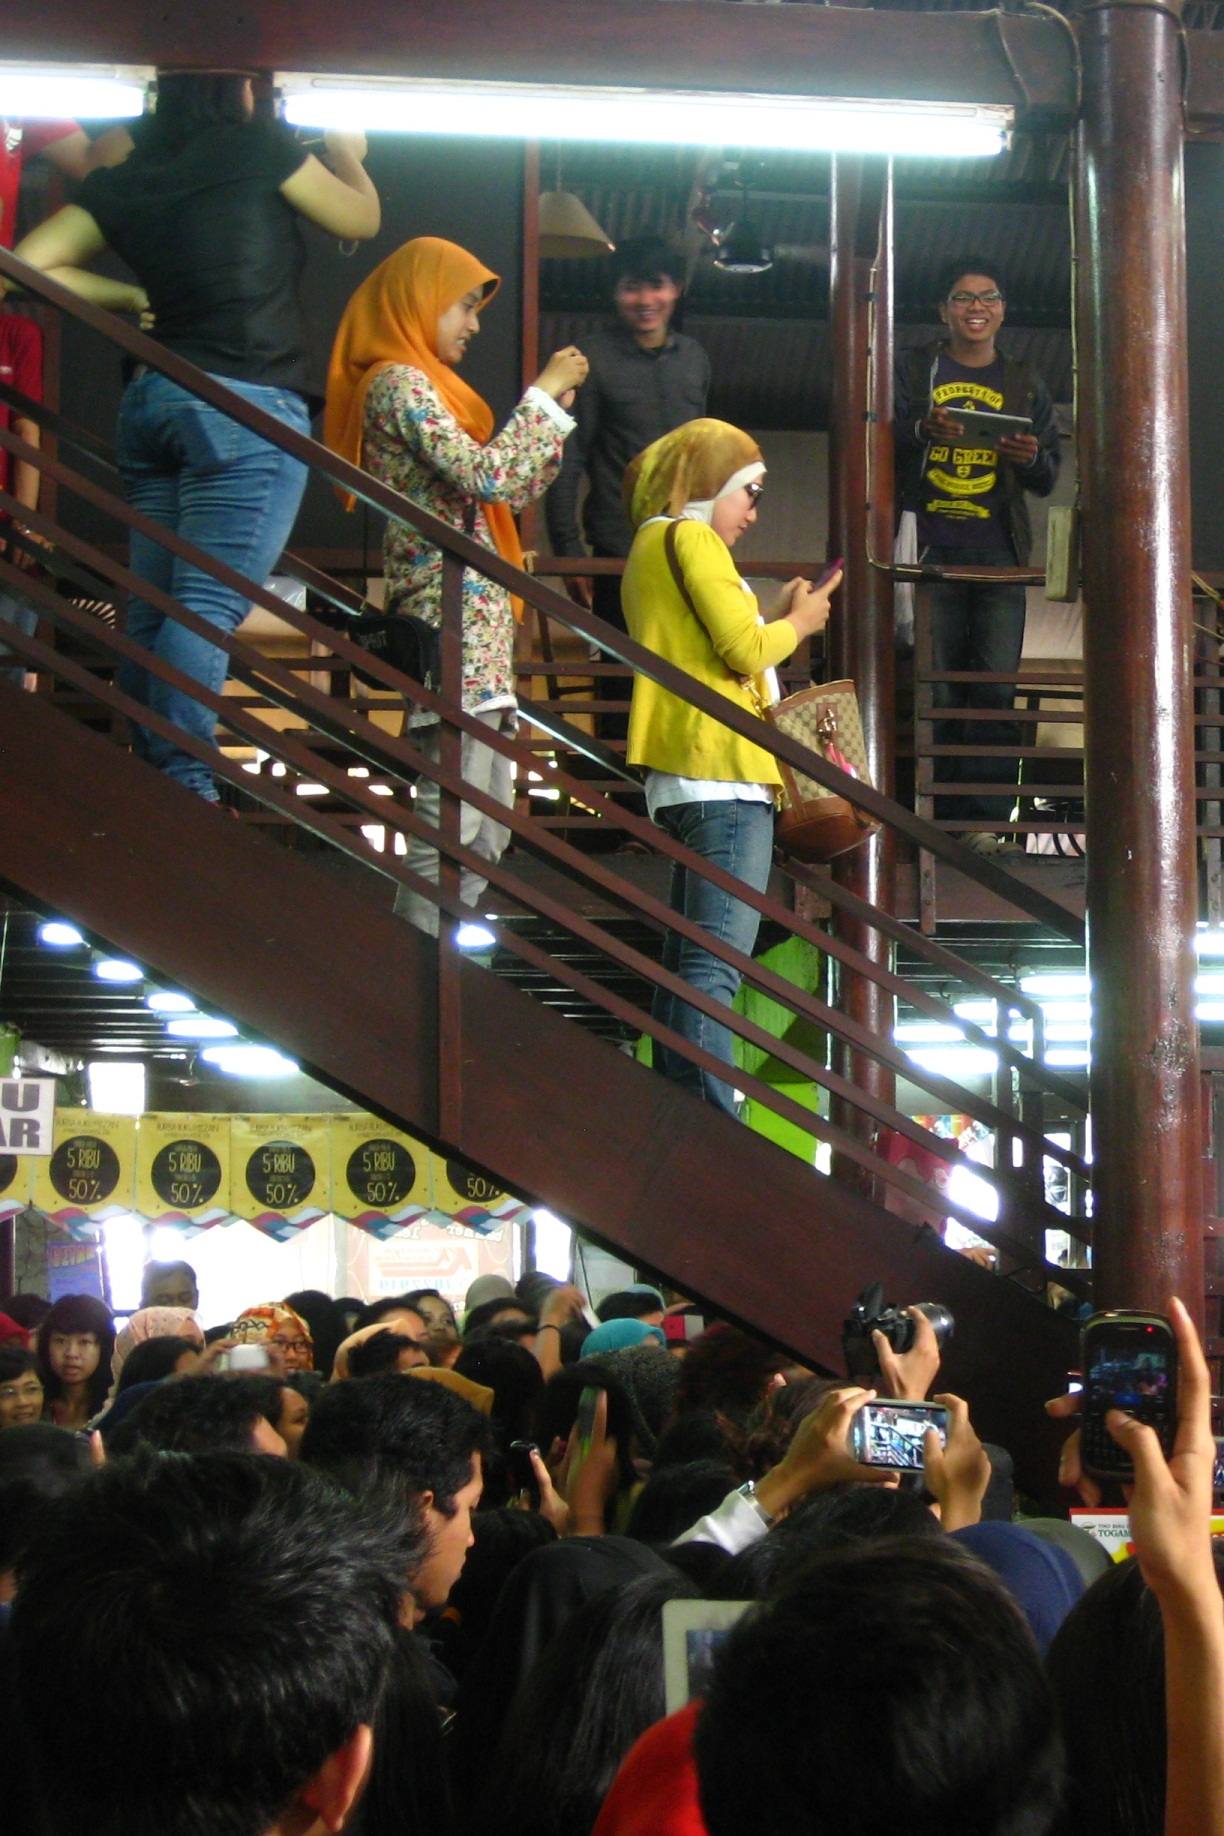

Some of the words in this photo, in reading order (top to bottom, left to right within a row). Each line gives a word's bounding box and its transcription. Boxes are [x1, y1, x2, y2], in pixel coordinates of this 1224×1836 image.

[953, 448, 998, 466] GREE
[0, 1117, 41, 1148] R
[66, 1148, 76, 1168] 5
[78, 1148, 100, 1168] RIBU
[168, 1152, 177, 1173] 5
[180, 1153, 201, 1173] RIBU
[262, 1153, 271, 1173] 5
[274, 1153, 296, 1173] RIBU
[363, 1152, 371, 1172] 5
[374, 1151, 395, 1172] RIBU
[69, 1178, 101, 1200] 50%
[171, 1183, 203, 1203] 50%
[266, 1184, 298, 1204] 50%
[367, 1181, 399, 1202] 50%
